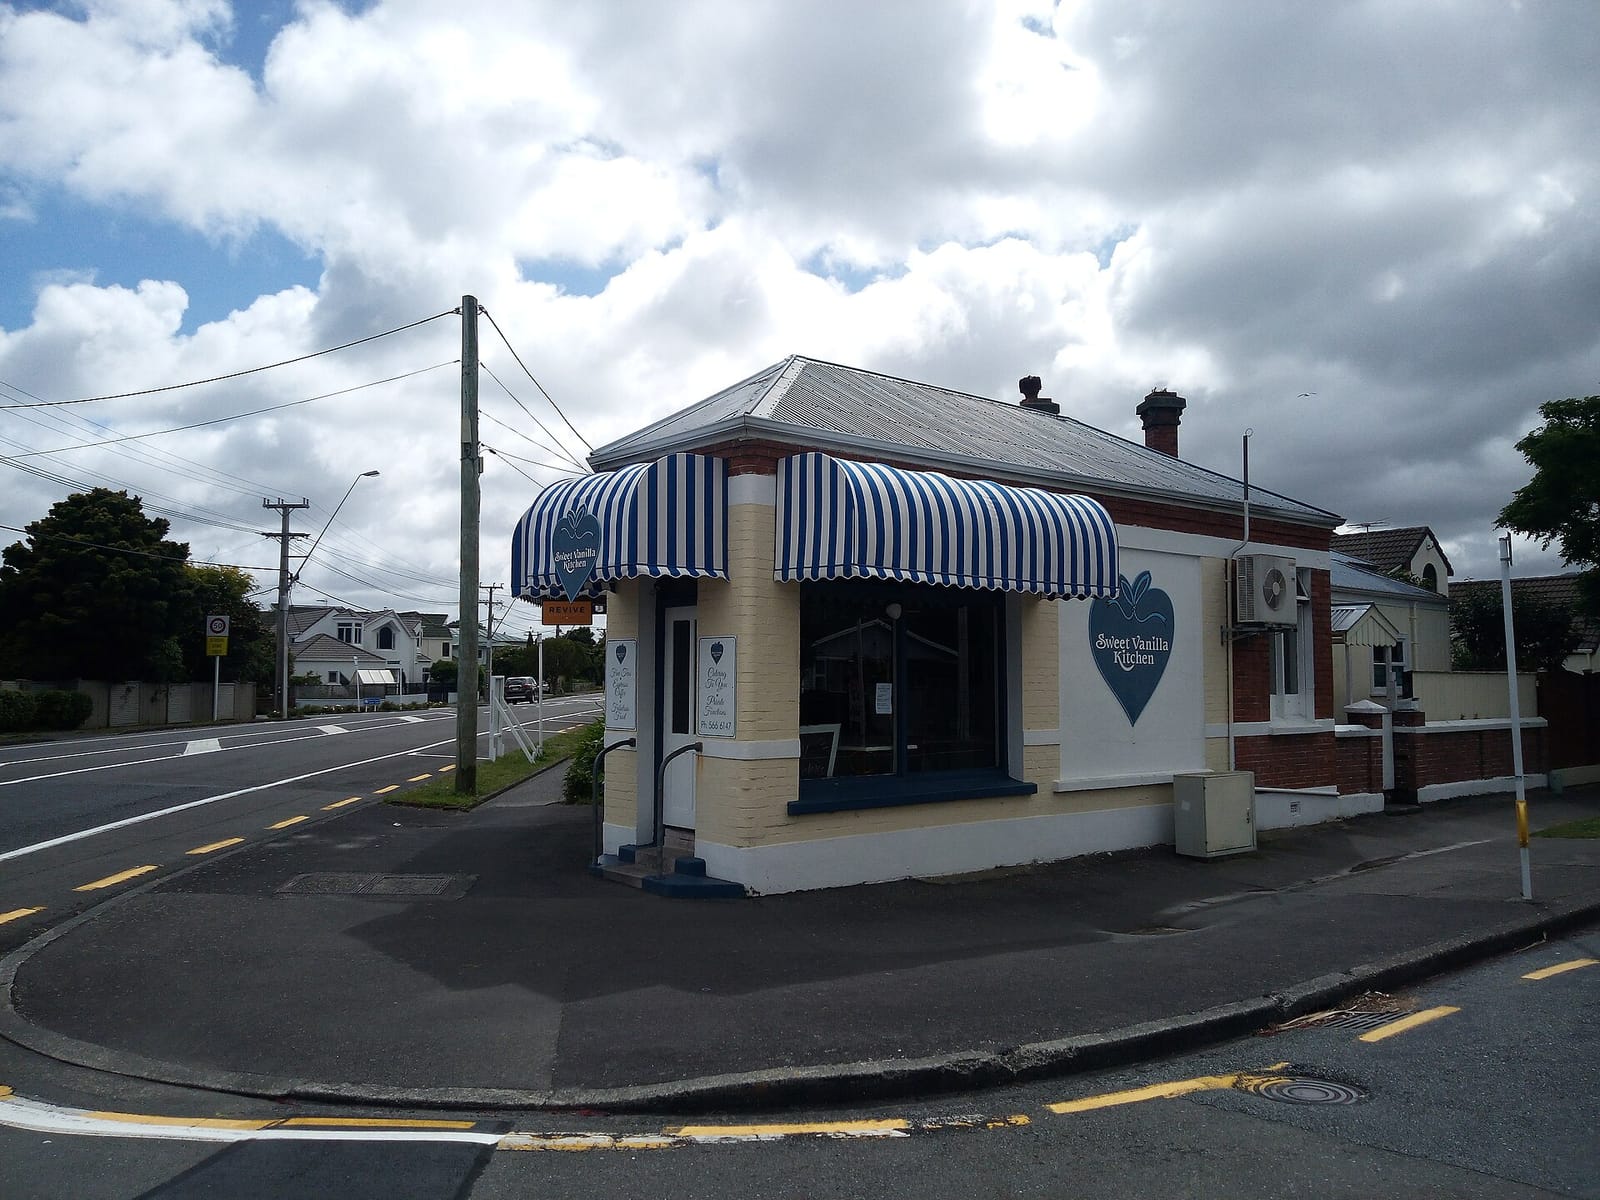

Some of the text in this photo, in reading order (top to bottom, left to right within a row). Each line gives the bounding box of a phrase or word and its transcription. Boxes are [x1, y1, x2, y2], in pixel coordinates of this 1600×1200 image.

[554, 548, 596, 562] Sweet Vanilla
[563, 559, 587, 573] Kitchen
[549, 606, 585, 614] REVIVE
[1096, 633, 1169, 651] Sweet Vanilla
[1114, 650, 1154, 671] Kitchen
[709, 720, 719, 730] 566
